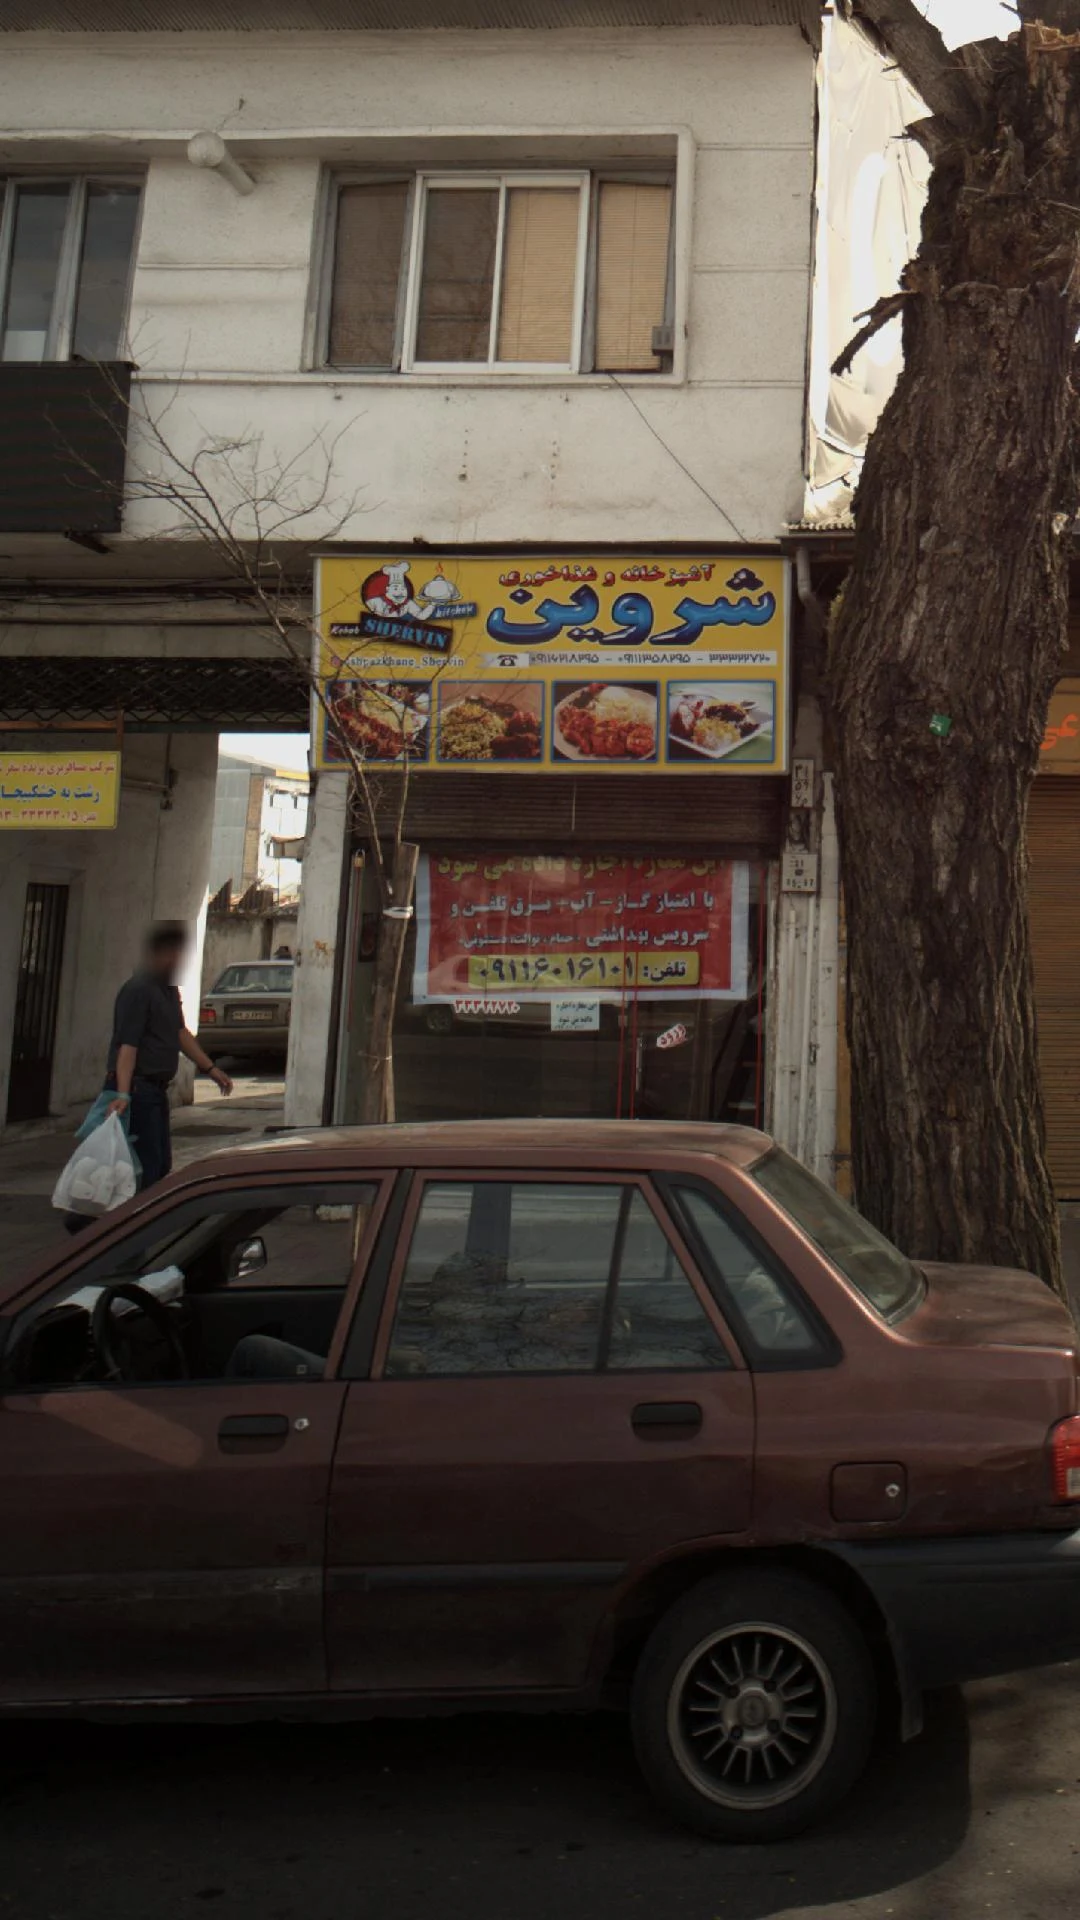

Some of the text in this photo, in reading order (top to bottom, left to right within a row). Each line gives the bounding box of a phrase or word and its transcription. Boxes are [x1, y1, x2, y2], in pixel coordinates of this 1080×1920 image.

[601, 567, 616, 587] و
[486, 567, 776, 645] شروین
[364, 618, 448, 648] SHERVIN
[1, 783, 57, 803] خشکبیجا
